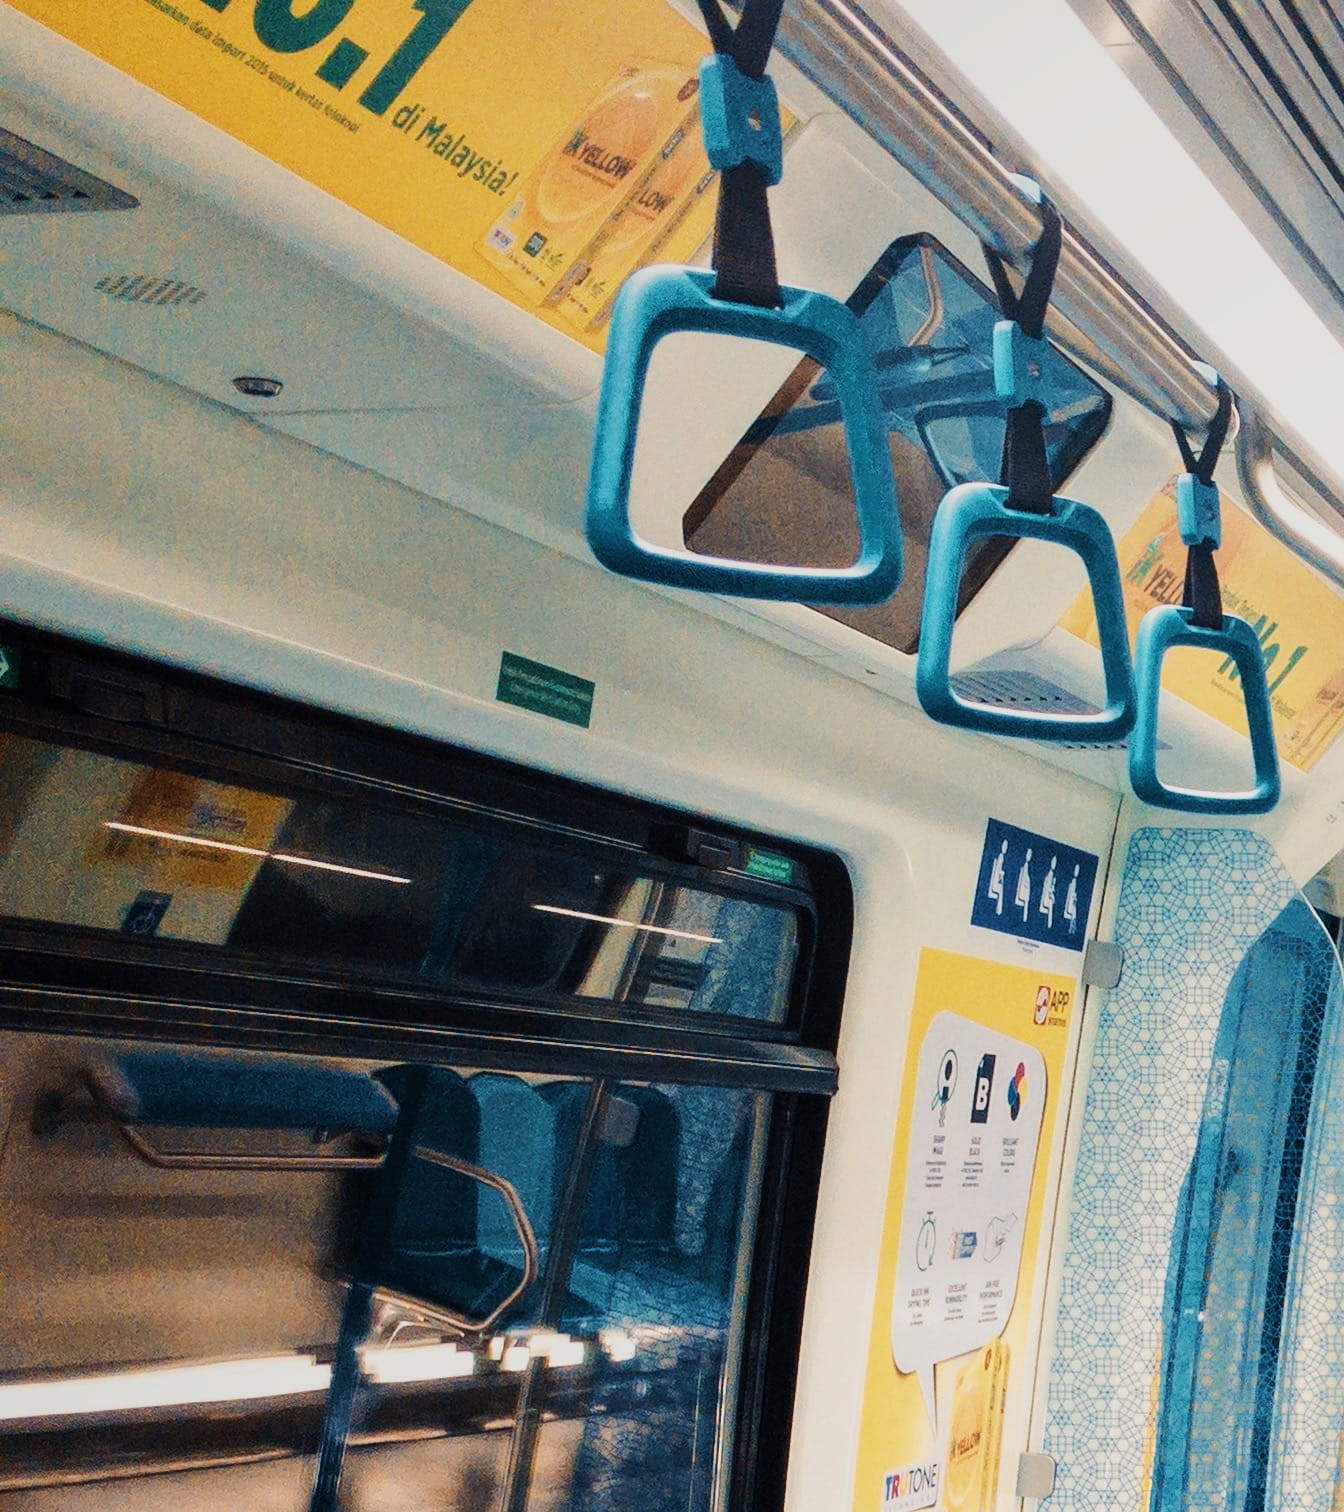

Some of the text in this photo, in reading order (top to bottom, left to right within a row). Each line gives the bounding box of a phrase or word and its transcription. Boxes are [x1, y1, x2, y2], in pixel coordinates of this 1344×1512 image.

[391, 103, 426, 134] di
[415, 116, 519, 196] Malaysia!
[577, 141, 637, 180] YELLOW
[637, 188, 674, 213] LOW
[1050, 991, 1070, 1013] APP
[886, 1463, 938, 1502] TRUTONE
